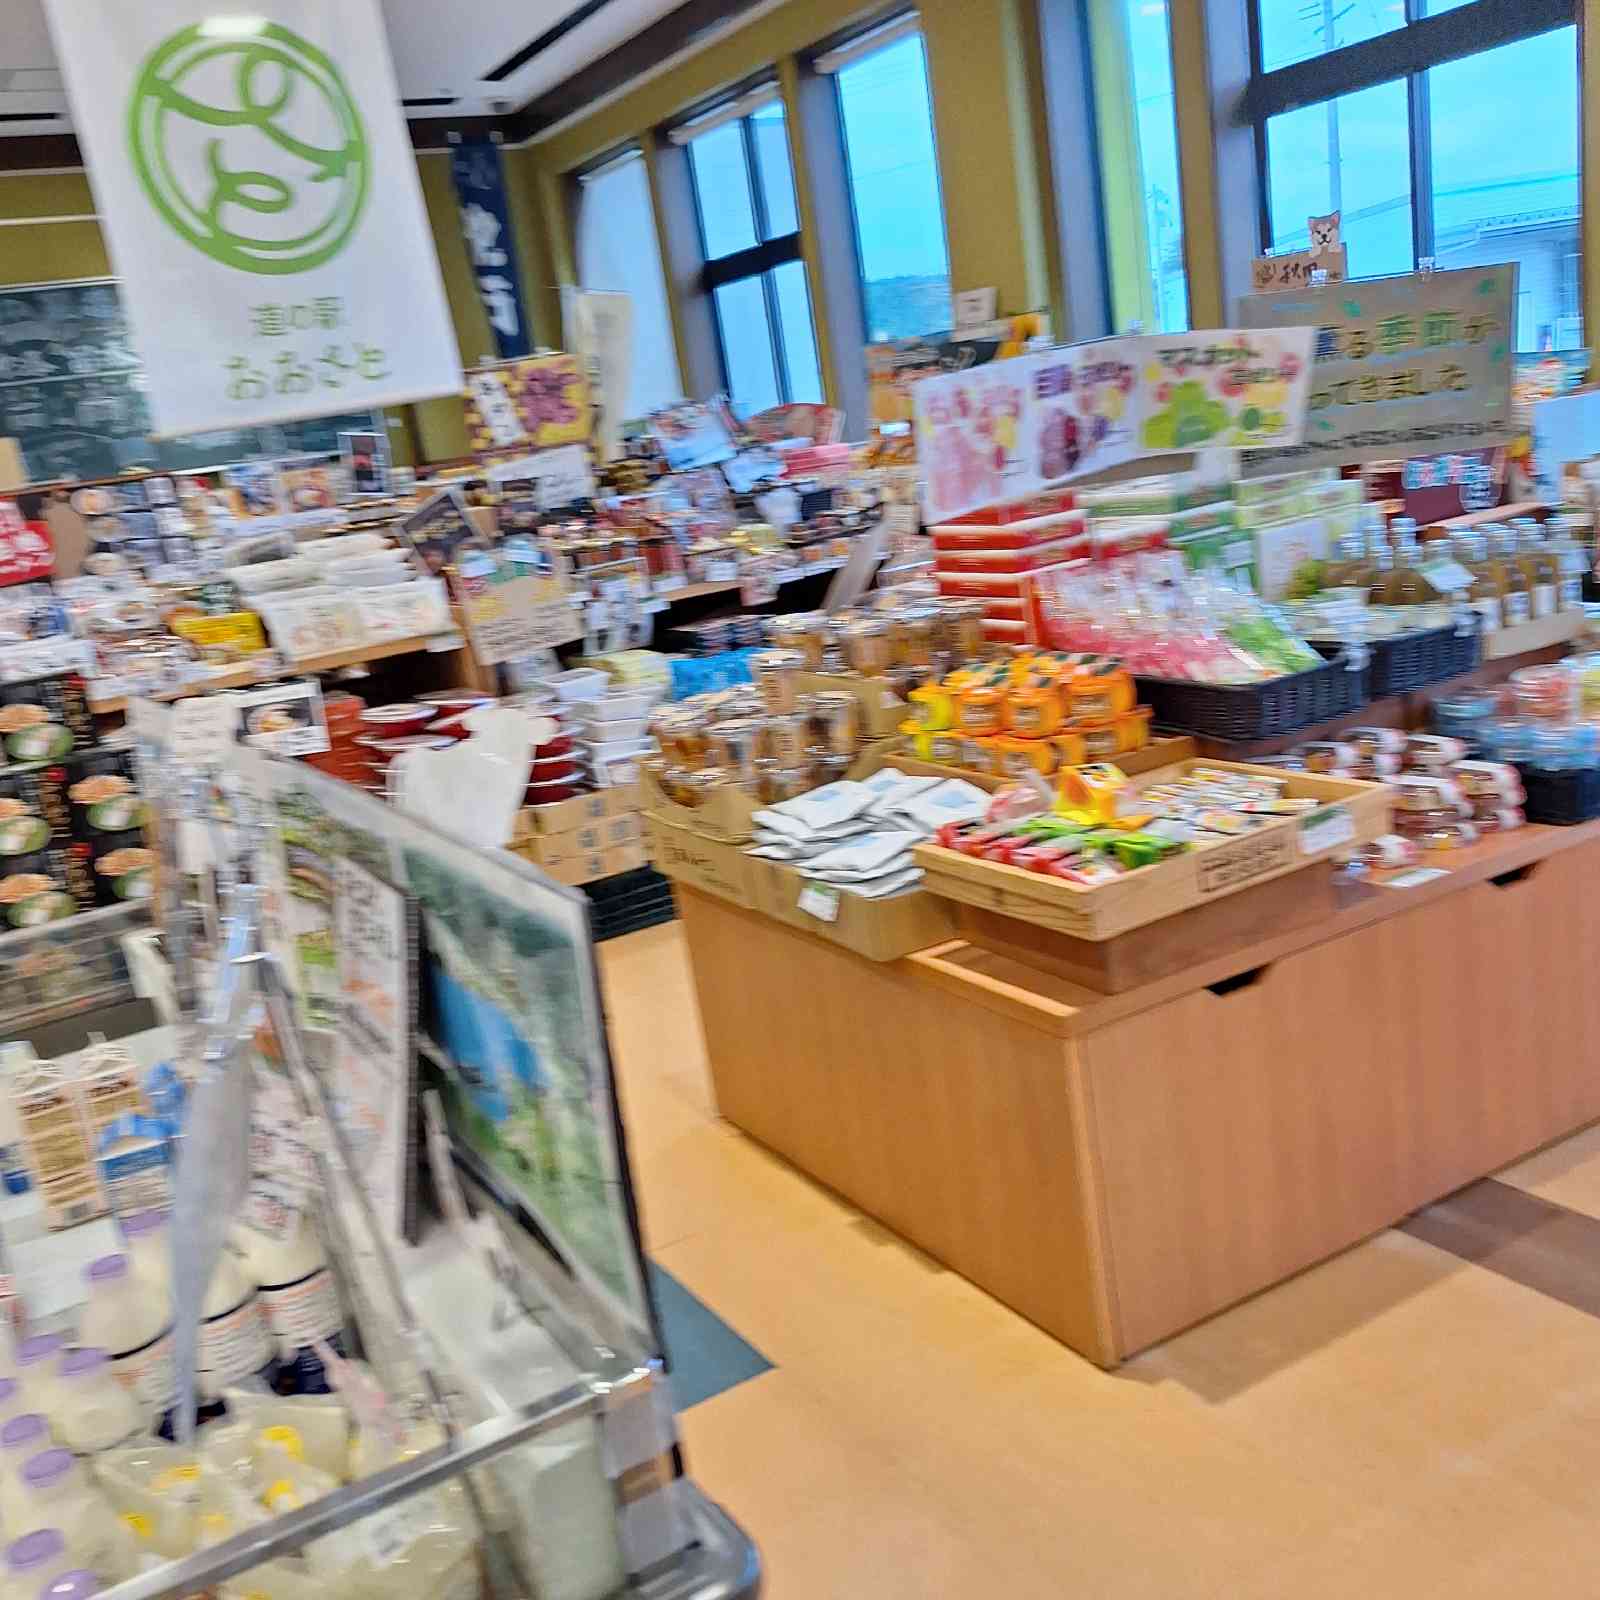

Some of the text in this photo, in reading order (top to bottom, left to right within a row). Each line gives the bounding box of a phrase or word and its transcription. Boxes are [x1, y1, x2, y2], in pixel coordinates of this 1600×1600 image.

[249, 296, 345, 336] 道の駅
[225, 342, 388, 401] おおさと
